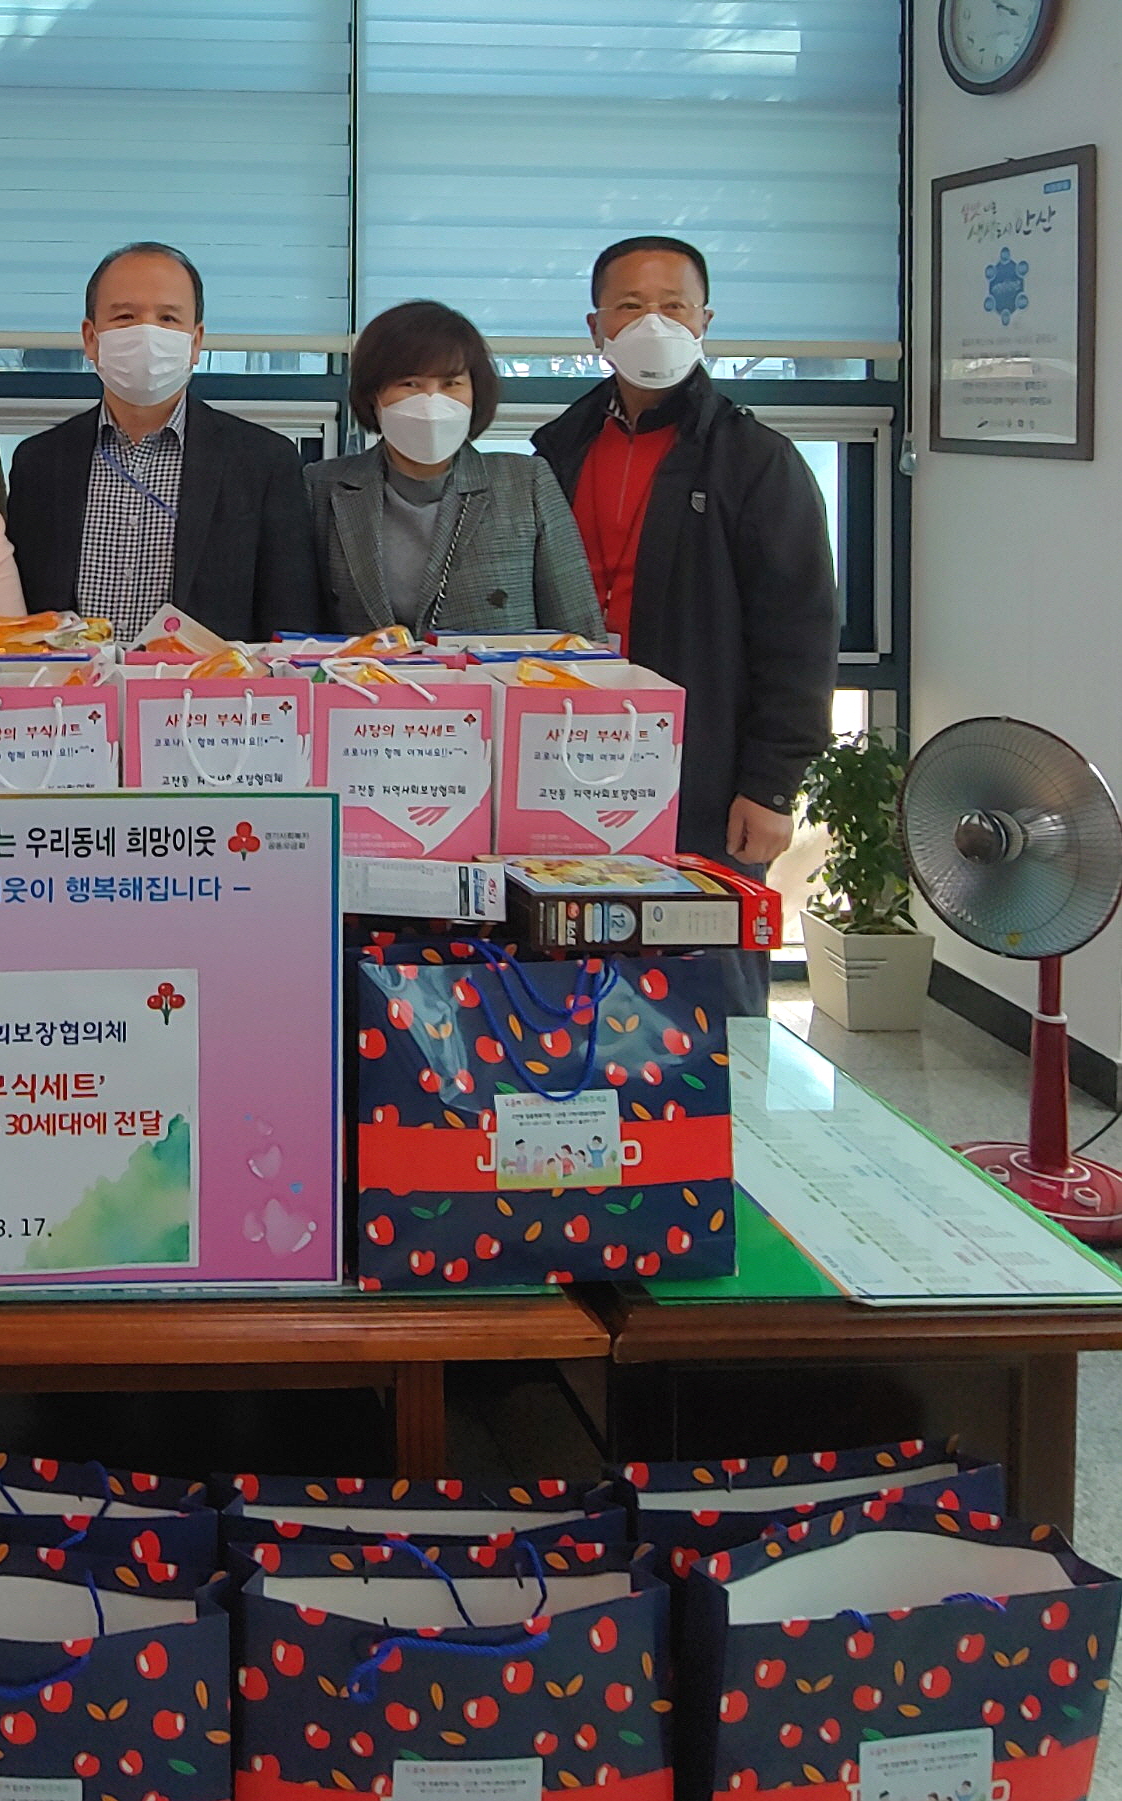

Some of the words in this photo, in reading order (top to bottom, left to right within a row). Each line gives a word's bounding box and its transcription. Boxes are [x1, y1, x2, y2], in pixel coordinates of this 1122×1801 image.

[403, 724, 457, 738] 부식세트
[348, 785, 375, 797] 고잔동
[539, 788, 566, 800] 고잔동
[26, 827, 116, 859] 우리동네
[126, 825, 216, 859] 희망이웃
[66, 876, 222, 902] 행복해집니다
[4, 1111, 108, 1138] 30세대에
[114, 1109, 164, 1136] 전달
[21, 1217, 52, 1238] 17.
